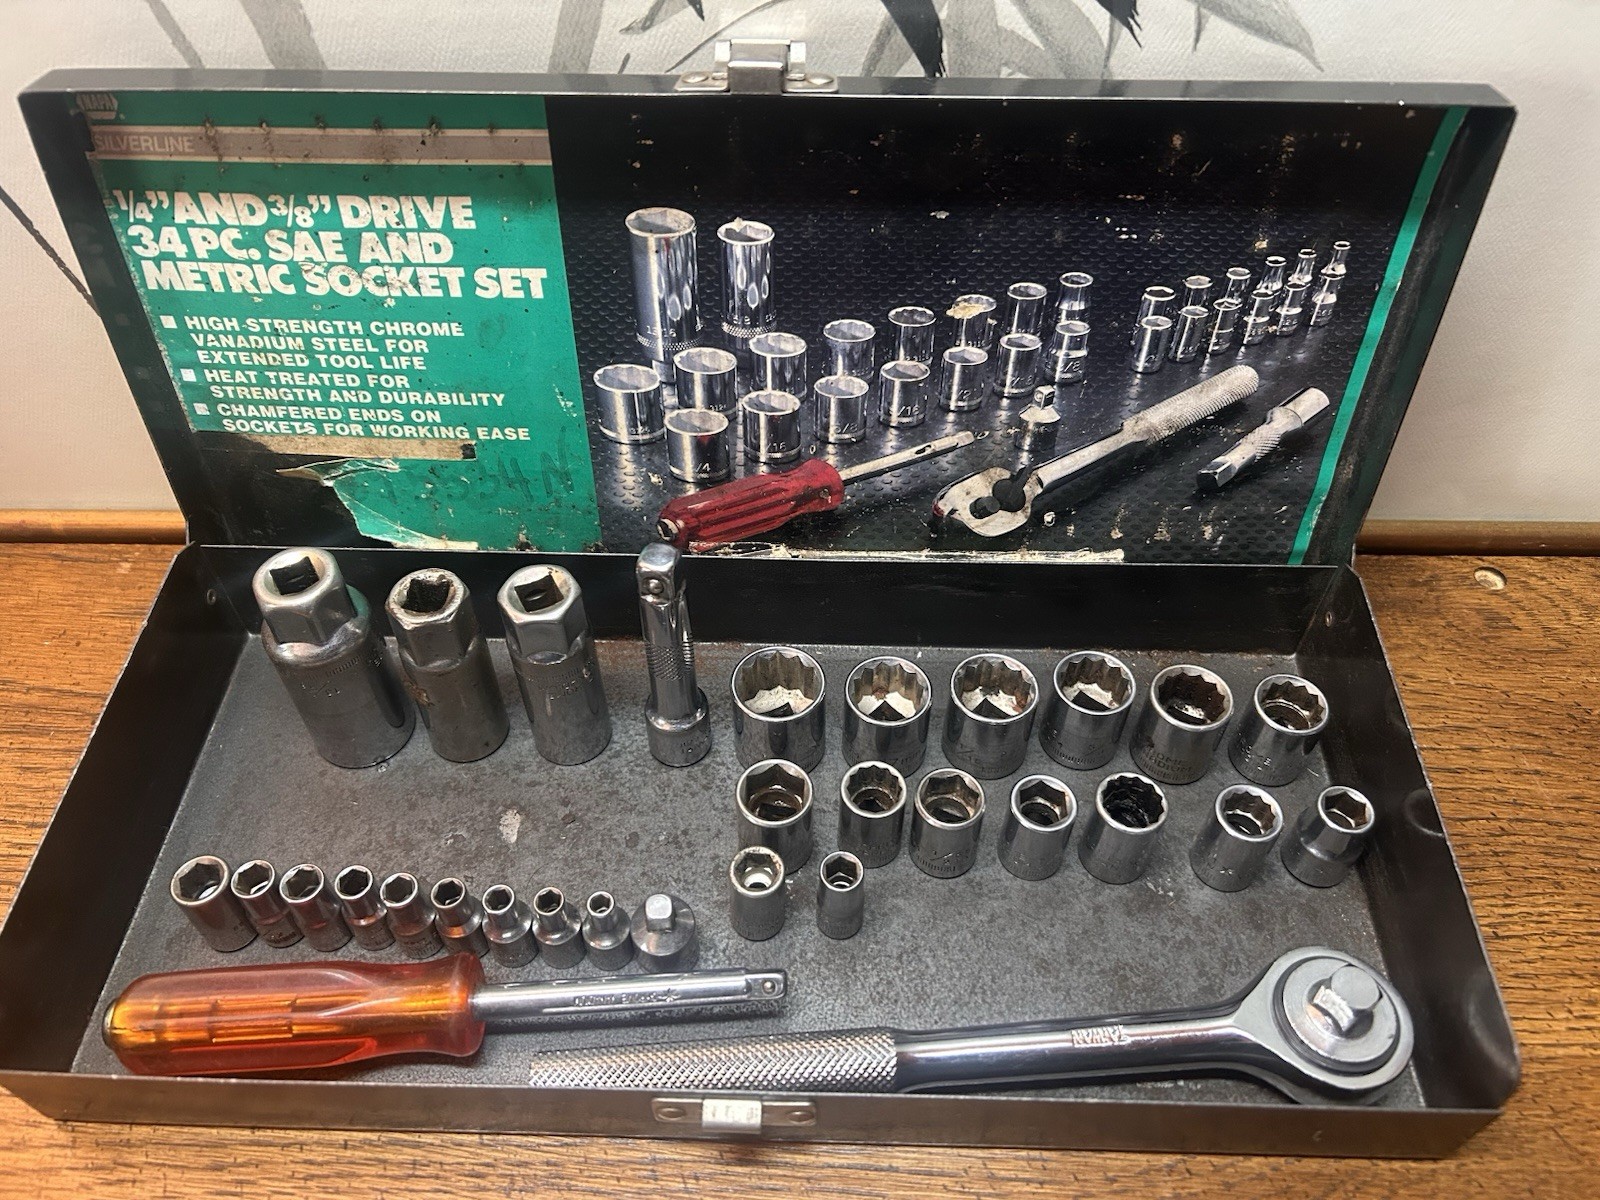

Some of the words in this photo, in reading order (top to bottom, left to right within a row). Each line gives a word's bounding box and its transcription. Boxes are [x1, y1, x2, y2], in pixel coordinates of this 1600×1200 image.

[94, 134, 195, 153] SILVERLINE
[174, 192, 268, 226] AND
[337, 195, 476, 229] DRIVE
[264, 229, 348, 263] SAE
[359, 231, 454, 264] AND
[140, 260, 296, 295] METRIC
[302, 263, 465, 298] SOCKET
[474, 267, 548, 299] SET
[184, 315, 240, 331] HIGH
[246, 318, 363, 335] STRENGTH
[370, 321, 465, 337] CHROME
[190, 333, 304, 350] VANADIUM
[312, 339, 379, 353] STEEL
[386, 339, 430, 354] FOR
[197, 350, 309, 368] EXTENDED
[315, 354, 374, 369] TOOL
[379, 355, 427, 371] LIFE
[204, 368, 258, 384] HEAT
[265, 371, 364, 387] TREATED
[368, 374, 411, 389] FOR
[209, 385, 322, 402] STRENGTH
[329, 390, 372, 403] AND
[378, 390, 505, 407] DURABILITY
[217, 403, 342, 421] CHAMFERED
[348, 407, 404, 422] ENDS
[411, 409, 441, 423] ON
[222, 418, 318, 436] SOCKETS
[322, 421, 364, 437] FOR
[369, 424, 470, 439] WORKING
[476, 426, 531, 441] EASE
